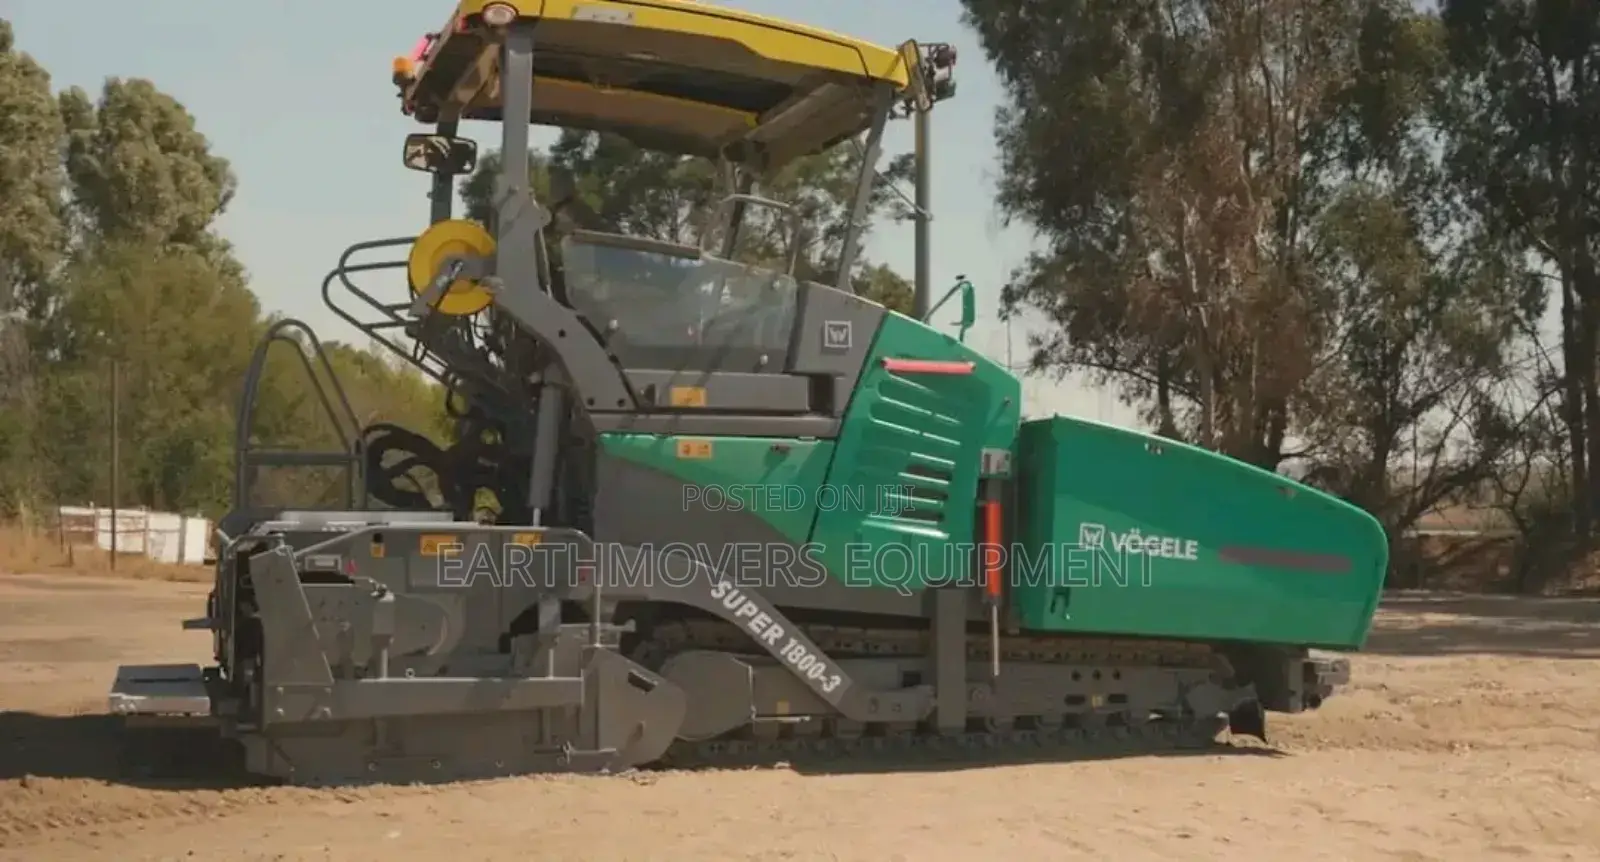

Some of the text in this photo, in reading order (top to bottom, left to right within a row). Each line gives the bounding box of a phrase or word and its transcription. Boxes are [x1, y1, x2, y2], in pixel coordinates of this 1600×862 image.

[1110, 527, 1198, 560] VÖGELE
[710, 580, 842, 693] SUPER 1800-3
